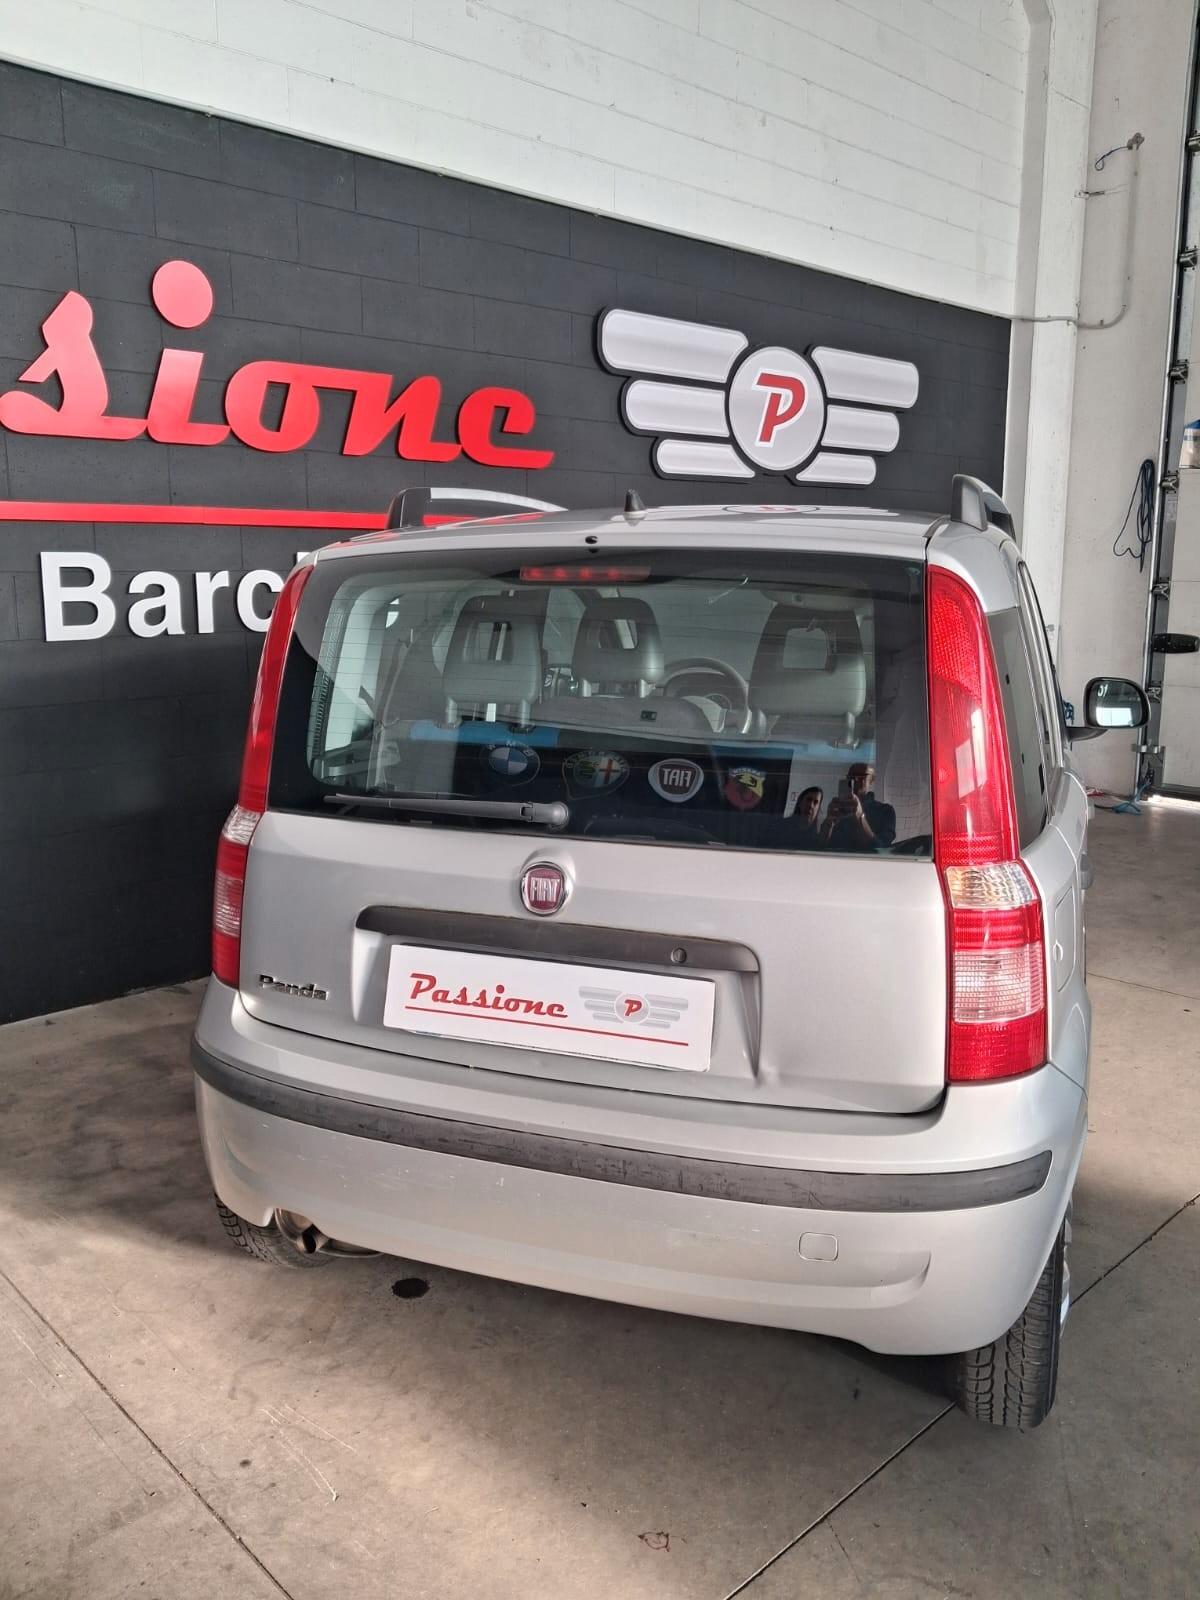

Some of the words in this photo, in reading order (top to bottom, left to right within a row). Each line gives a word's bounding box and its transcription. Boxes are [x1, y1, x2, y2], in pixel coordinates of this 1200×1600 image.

[0, 260, 555, 469] sione
[756, 372, 805, 442] P
[40, 551, 310, 642] Barc
[530, 876, 561, 902] FIAT
[259, 973, 329, 1001] Panda
[406, 972, 568, 1018] Passione
[624, 999, 642, 1017] P
